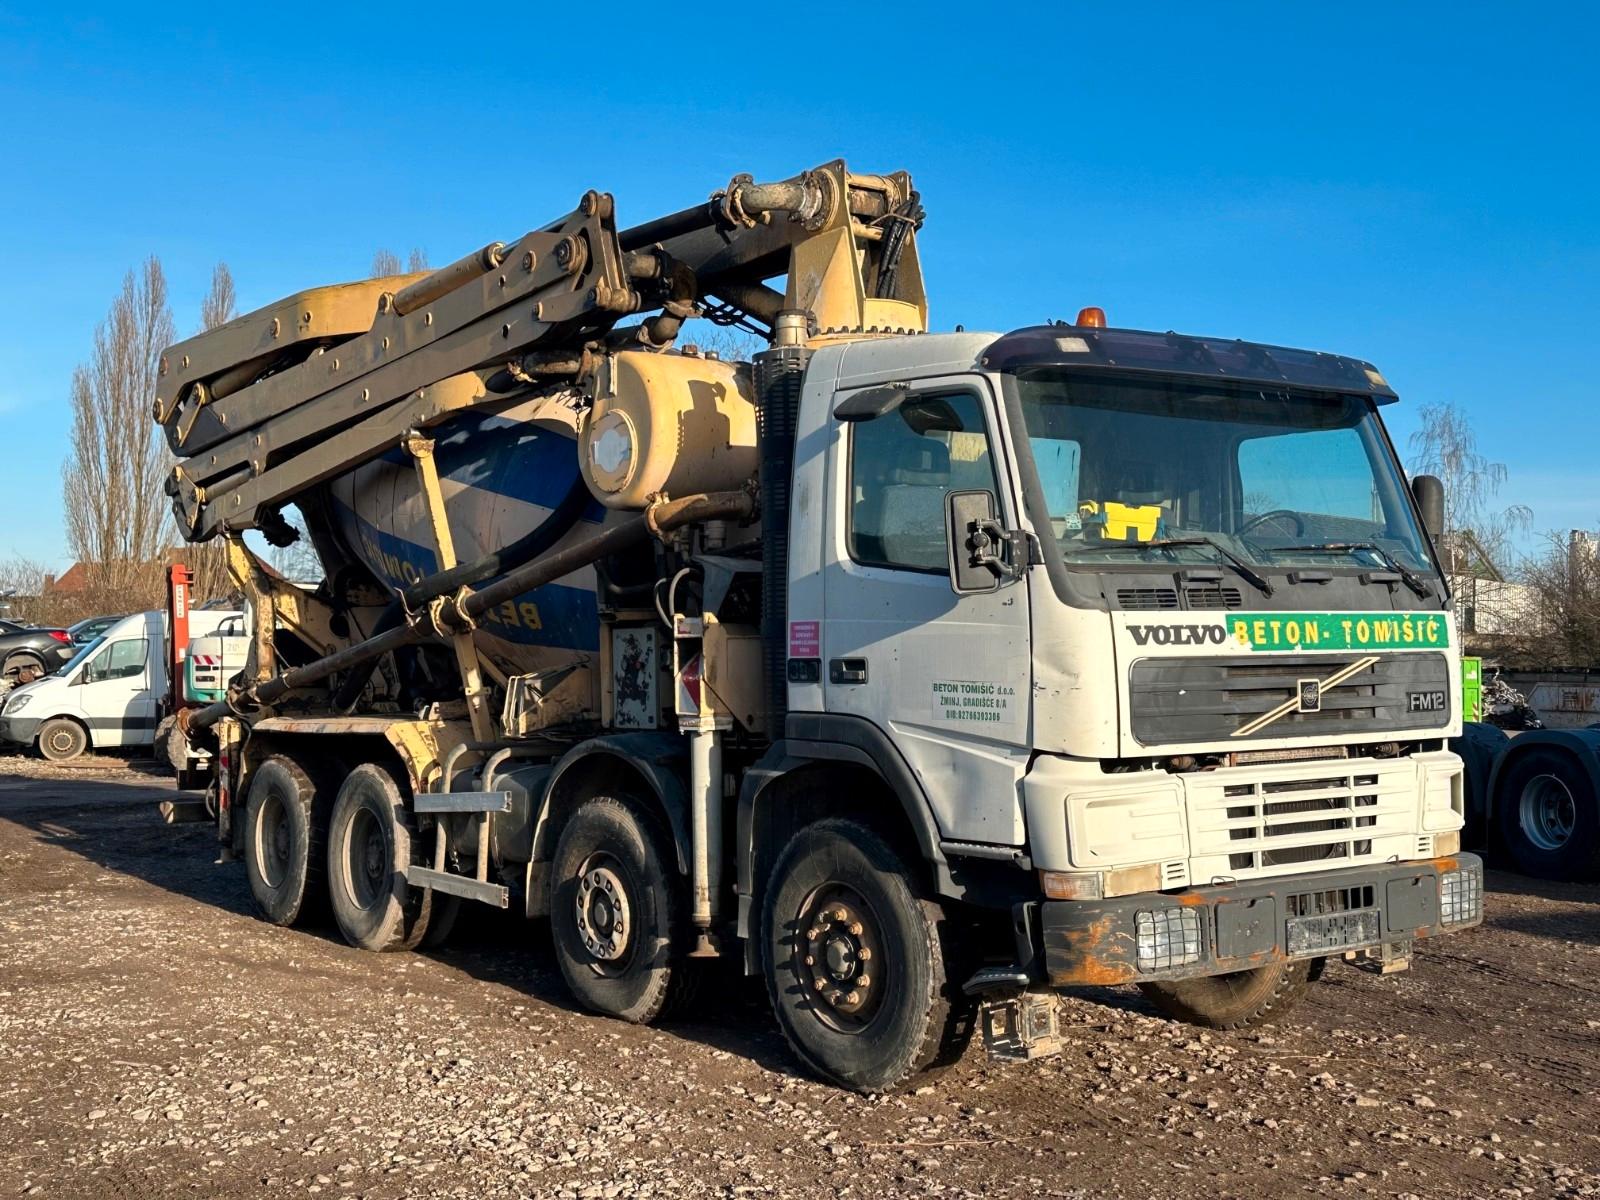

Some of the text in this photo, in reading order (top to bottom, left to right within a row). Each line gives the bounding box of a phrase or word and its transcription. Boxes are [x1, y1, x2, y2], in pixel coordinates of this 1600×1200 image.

[1126, 624, 1226, 646] VOLVO
[1341, 615, 1440, 644] TOMIŠIĆ
[933, 682, 1016, 696] BETON TOMIŠIĆ d.o.o.
[1410, 692, 1445, 711] FM12
